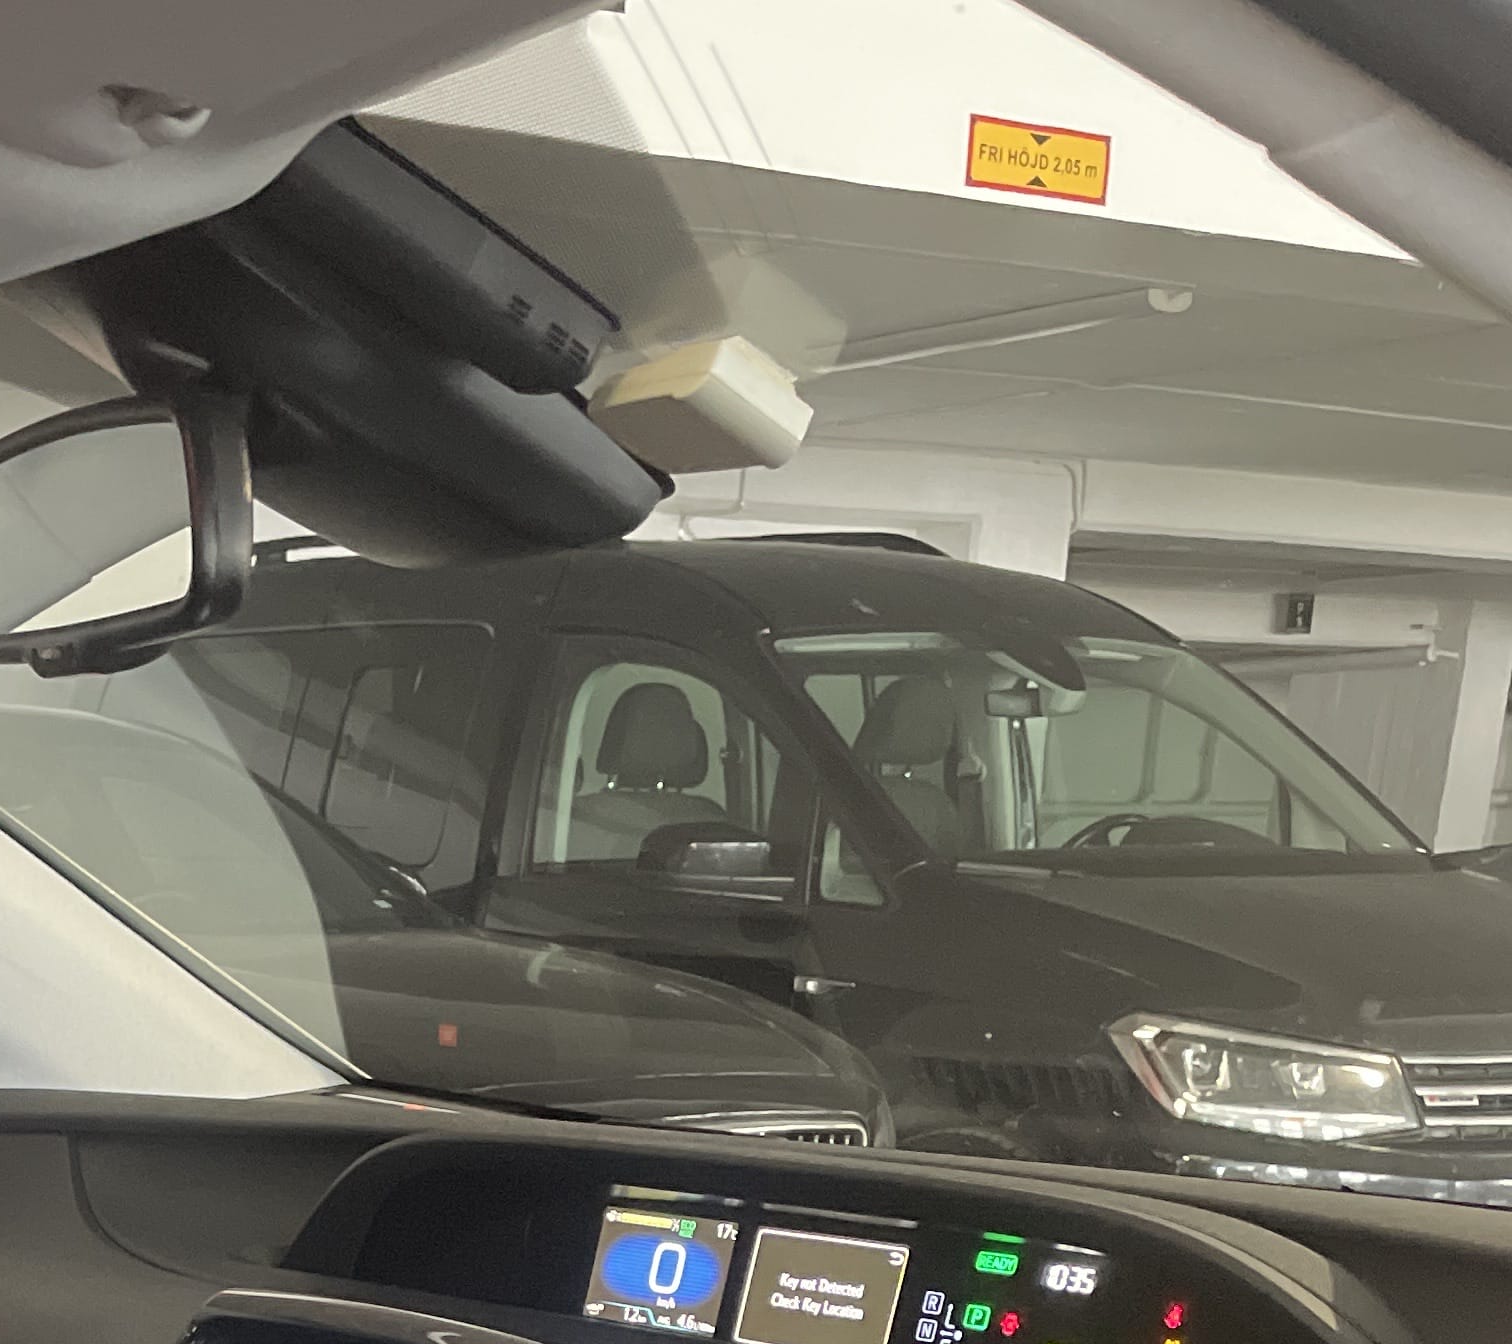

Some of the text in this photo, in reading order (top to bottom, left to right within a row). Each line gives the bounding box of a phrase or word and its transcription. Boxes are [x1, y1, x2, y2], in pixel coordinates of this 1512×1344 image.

[978, 143, 1098, 178] FRI HÖJD 2,05 m
[648, 1242, 687, 1295] 0
[978, 1255, 1015, 1271] READY
[779, 1272, 800, 1291] Key
[818, 1278, 865, 1299] Detected
[770, 1292, 864, 1320] Check Key Location
[927, 1295, 939, 1311] R
[970, 1308, 984, 1326] P
[920, 1322, 933, 1338] N
